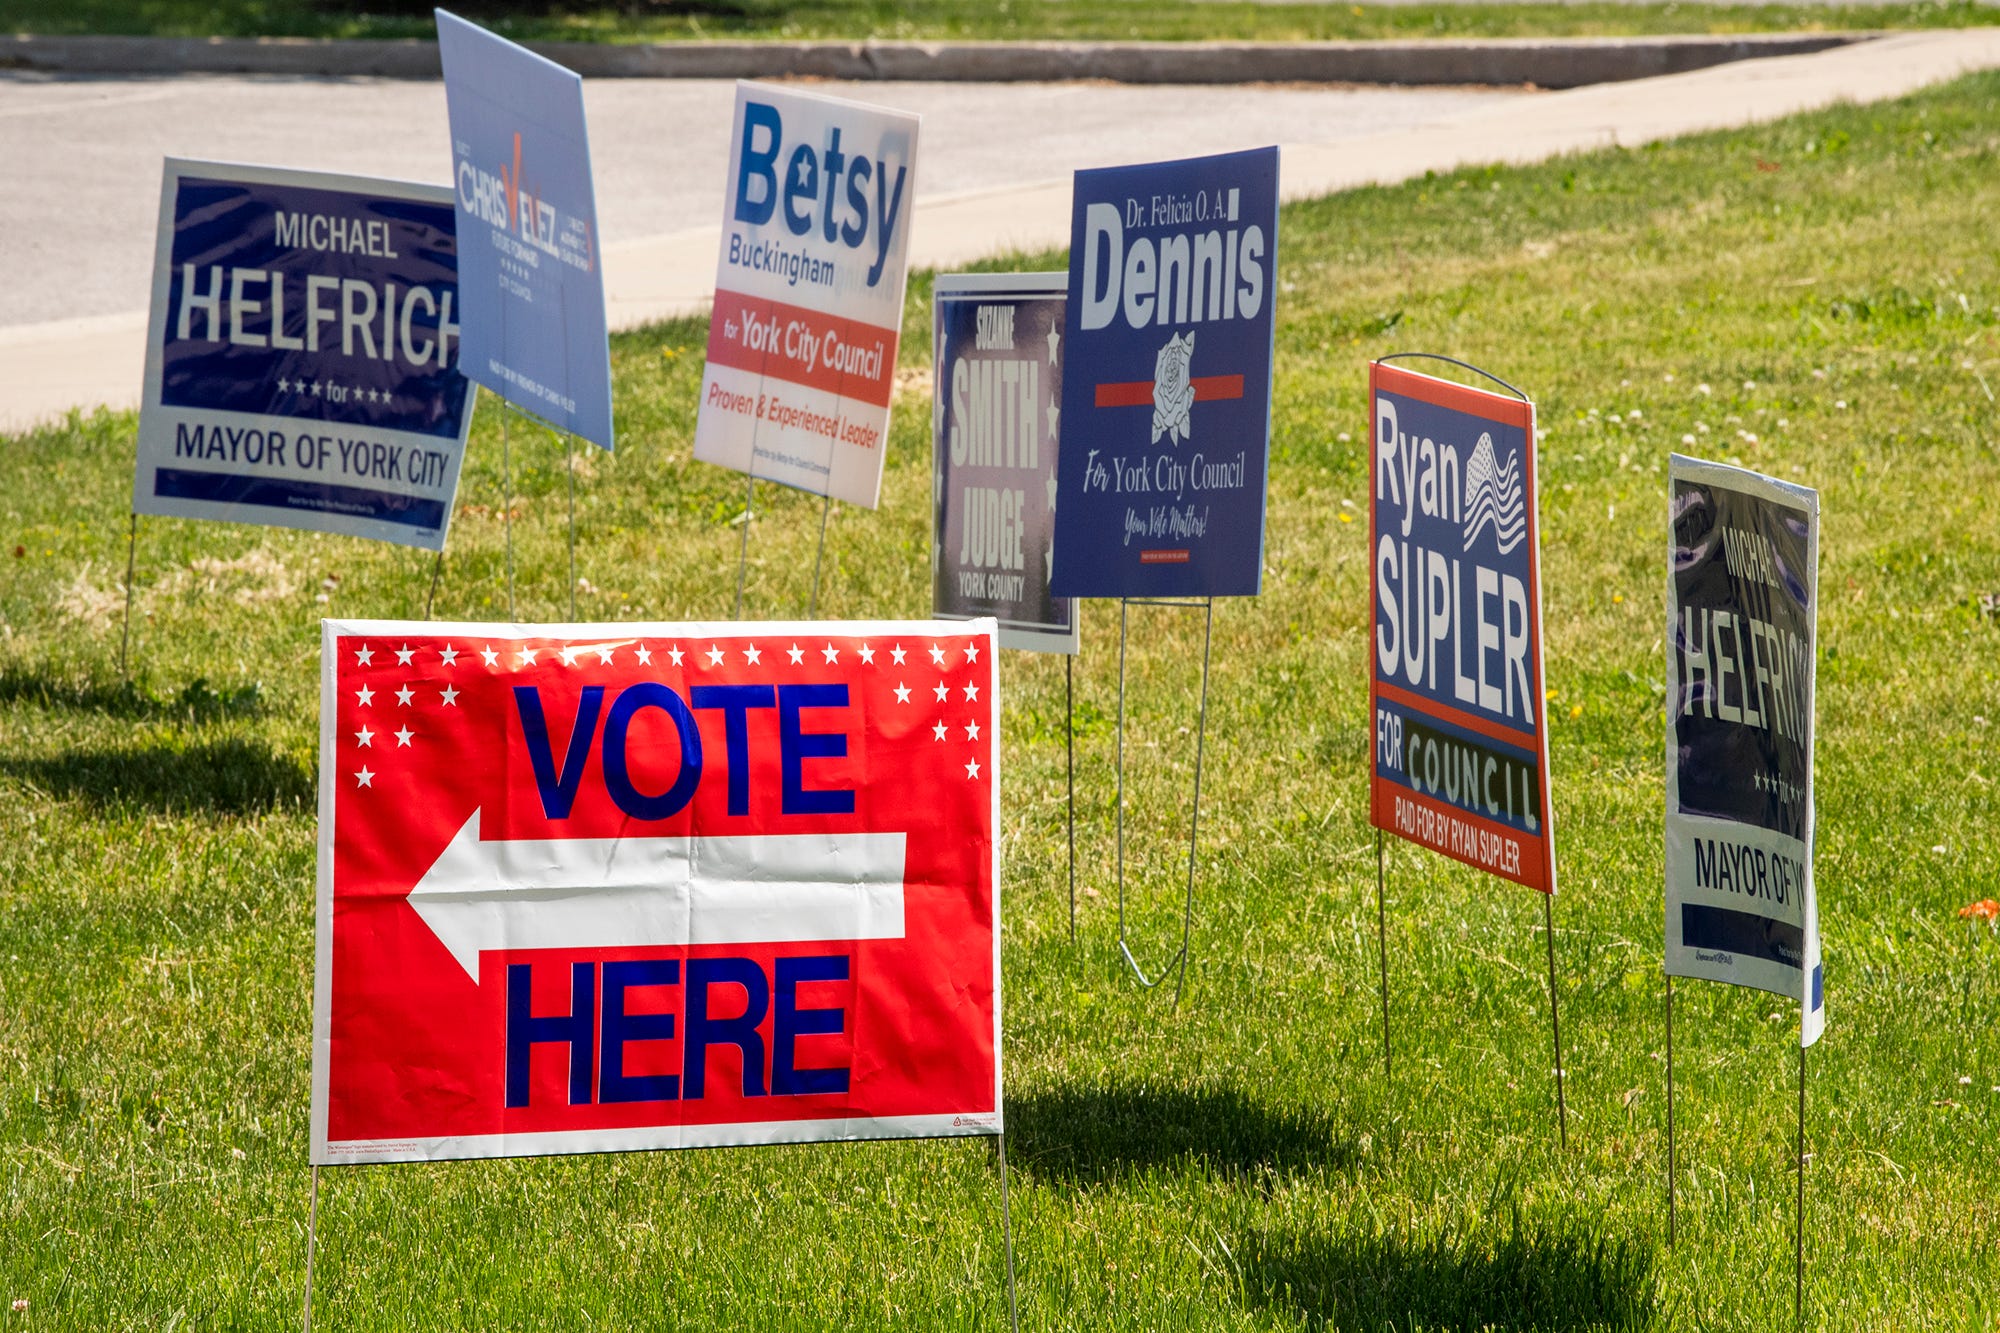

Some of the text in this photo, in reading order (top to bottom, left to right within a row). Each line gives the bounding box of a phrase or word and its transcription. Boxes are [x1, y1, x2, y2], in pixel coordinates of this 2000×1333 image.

[459, 160, 506, 230] CHRIS
[734, 101, 907, 287] Betsy
[1126, 198, 1146, 229] Dr.
[1151, 194, 1192, 226] Felicia
[1195, 190, 1209, 222] O.
[275, 211, 398, 258] MICHAEL
[728, 232, 835, 287] Buckingham
[1081, 188, 1264, 330] Dennis
[724, 309, 884, 381] for York City Council
[976, 305, 1015, 350] SUZANNE
[327, 380, 347, 403] for
[707, 382, 879, 449] Proven & Experienced Leader
[950, 357, 1038, 468] SMITH
[175, 423, 448, 488] MAYOR OF YORK CITY
[1083, 449, 1245, 501] For York City Council
[1377, 397, 1460, 537] Ryan
[960, 487, 1024, 570] JUDGE
[1124, 504, 1209, 546] Your Vote Matters!
[959, 571, 1025, 602] YORK COUNTY
[1377, 534, 1534, 725] SUPLER
[514, 683, 856, 821] VOTE
[1377, 709, 1537, 830] FOR COUNCIL
[1395, 796, 1521, 876] PAID FOR BY RYAN SUPLER
[1694, 838, 1770, 900] MAYOR
[1773, 852, 1791, 905] OF
[505, 954, 850, 1108] HERE
